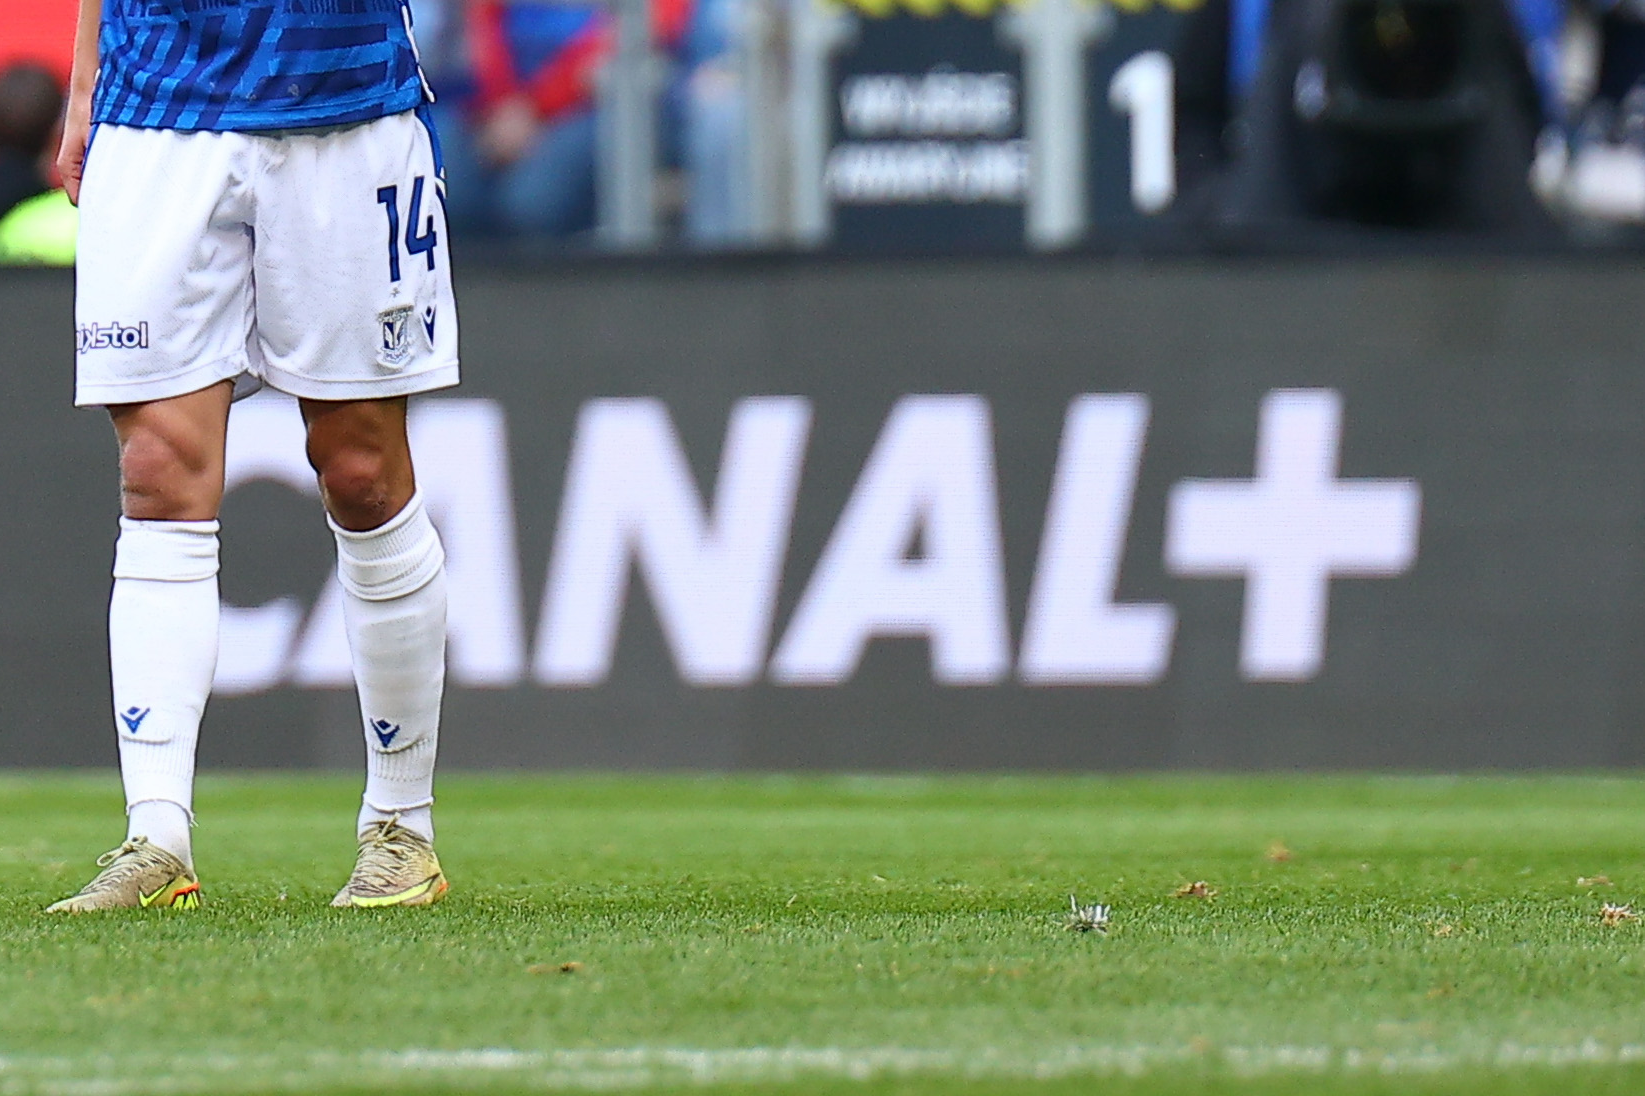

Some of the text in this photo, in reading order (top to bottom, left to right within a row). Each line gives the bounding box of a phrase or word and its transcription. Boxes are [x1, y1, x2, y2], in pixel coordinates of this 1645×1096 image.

[1108, 50, 1176, 212] 1
[376, 175, 438, 283] 14
[213, 386, 1424, 688] CANAL+
